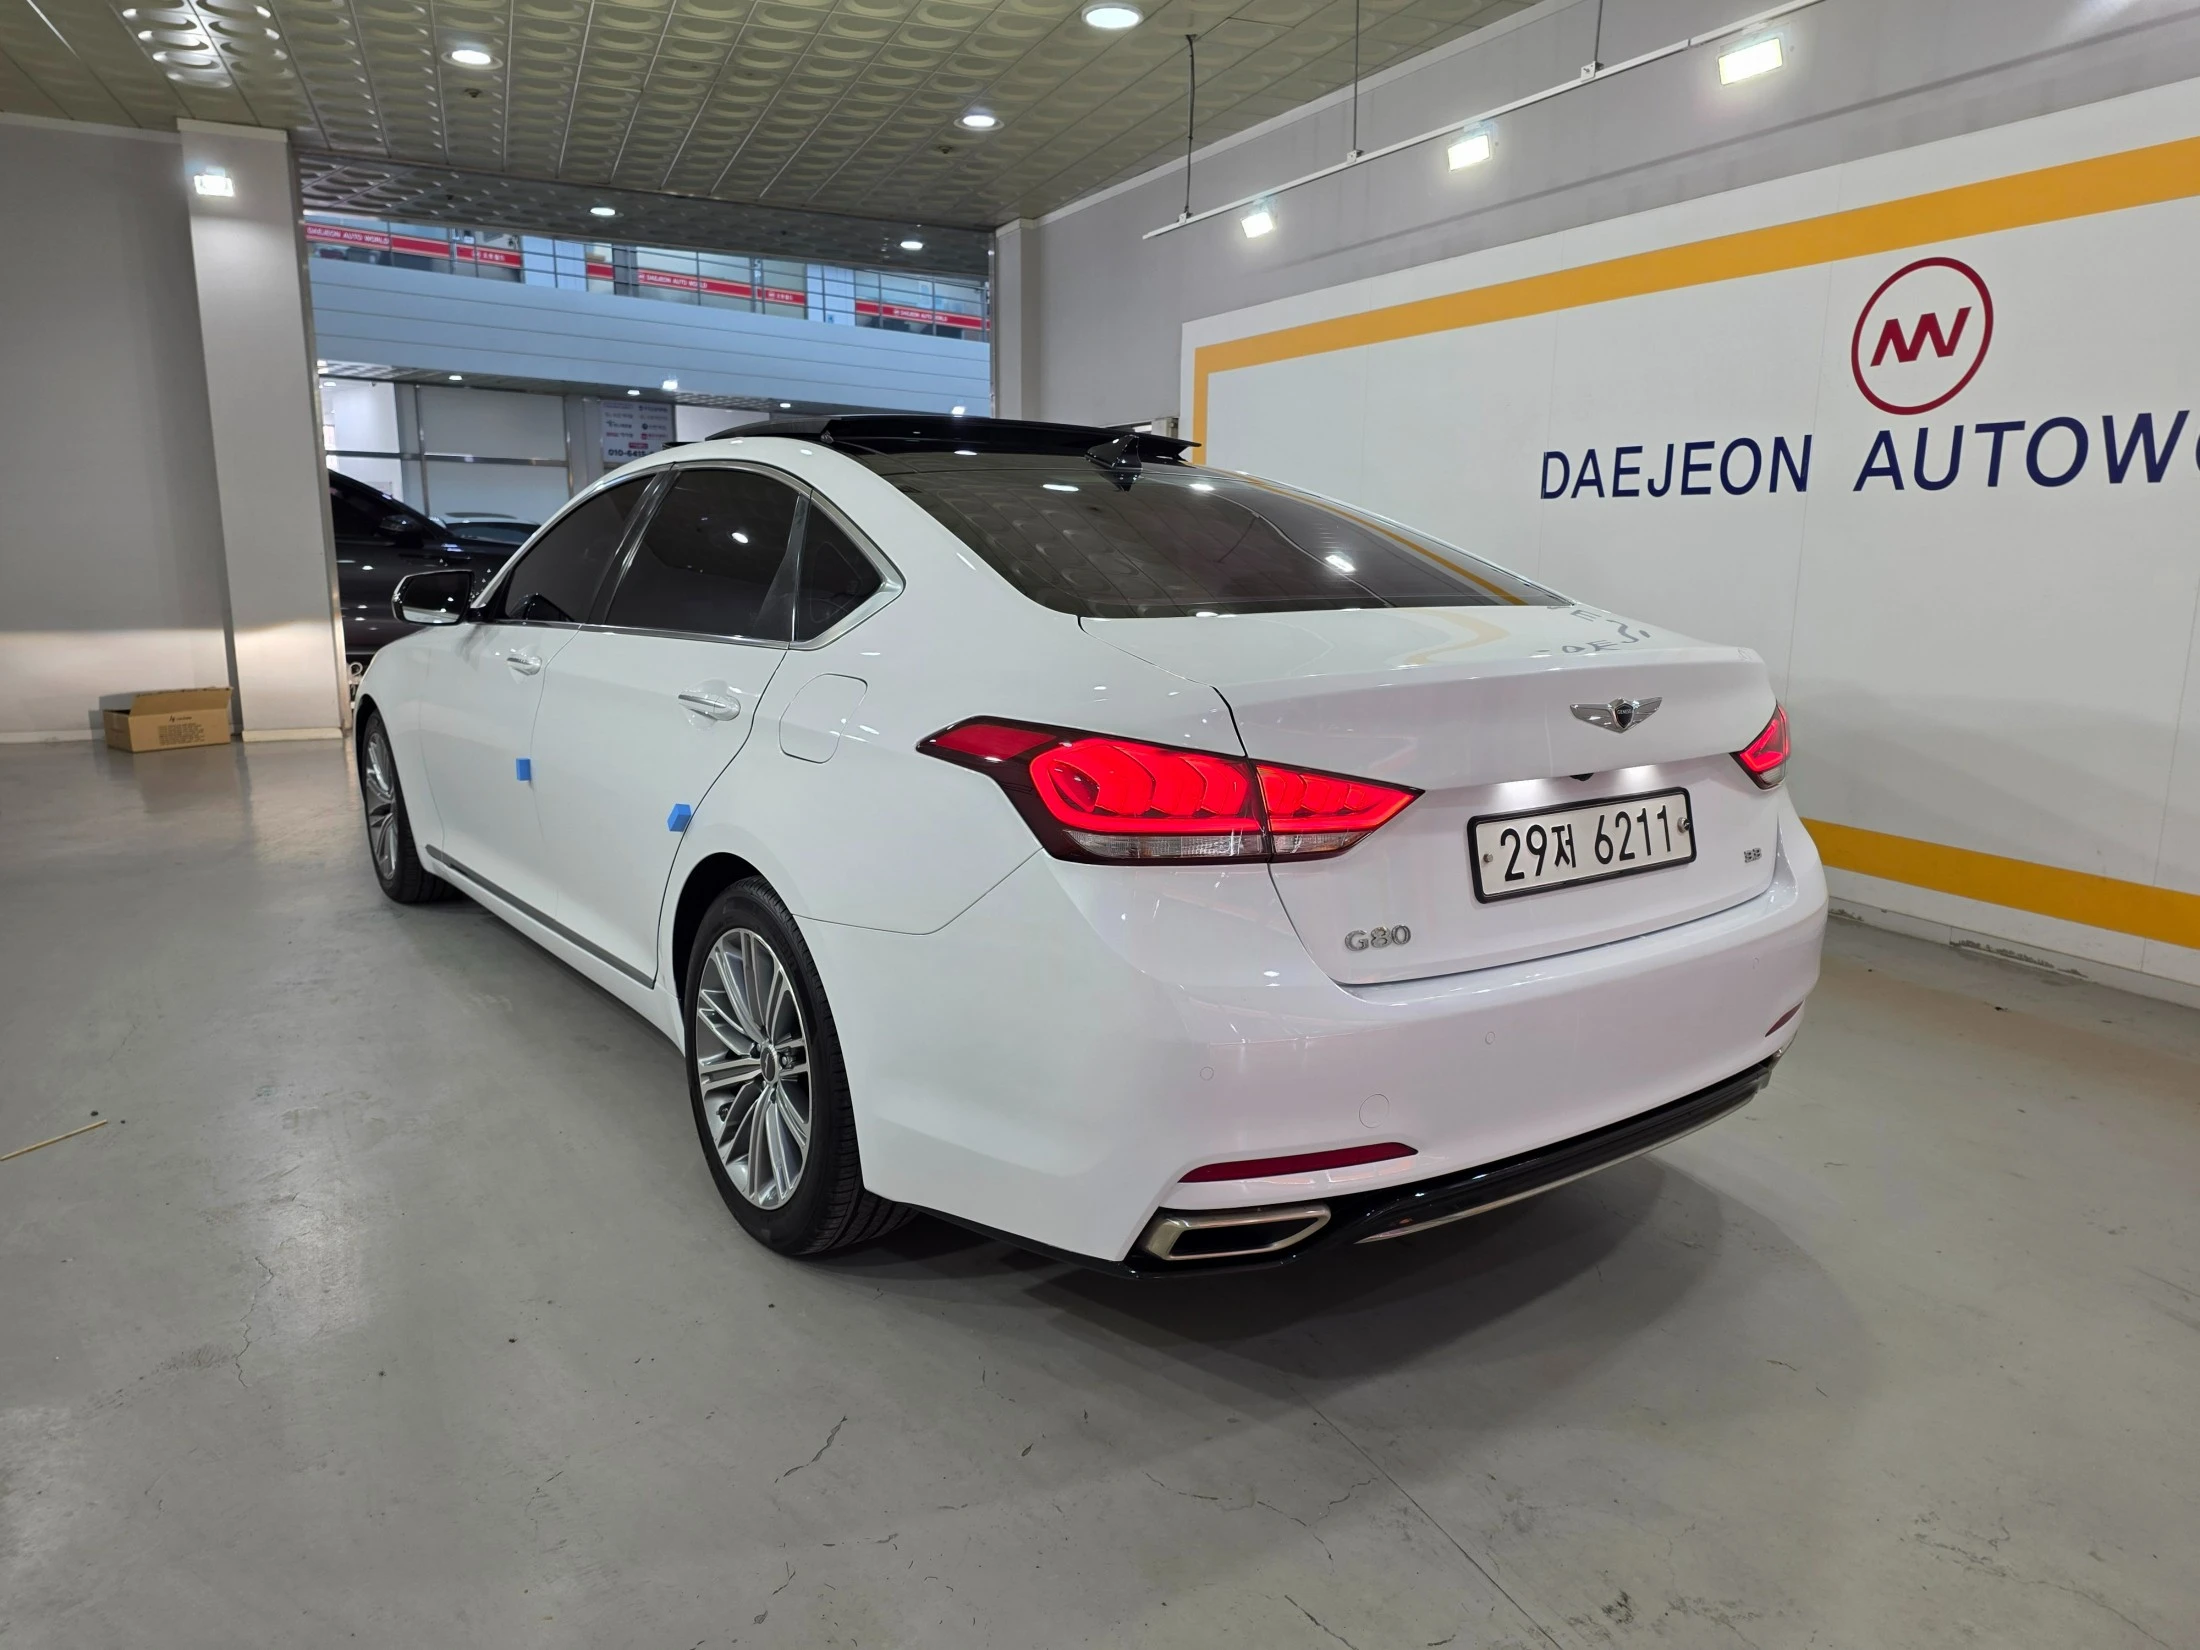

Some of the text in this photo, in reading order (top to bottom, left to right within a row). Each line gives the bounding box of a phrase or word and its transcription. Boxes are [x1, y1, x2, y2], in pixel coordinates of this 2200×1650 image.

[342, 231, 363, 242] AUTO
[1541, 409, 2200, 500] DAEJEON AUTOW
[1500, 804, 1671, 882] 29저 6211
[1344, 924, 1412, 952] G80
